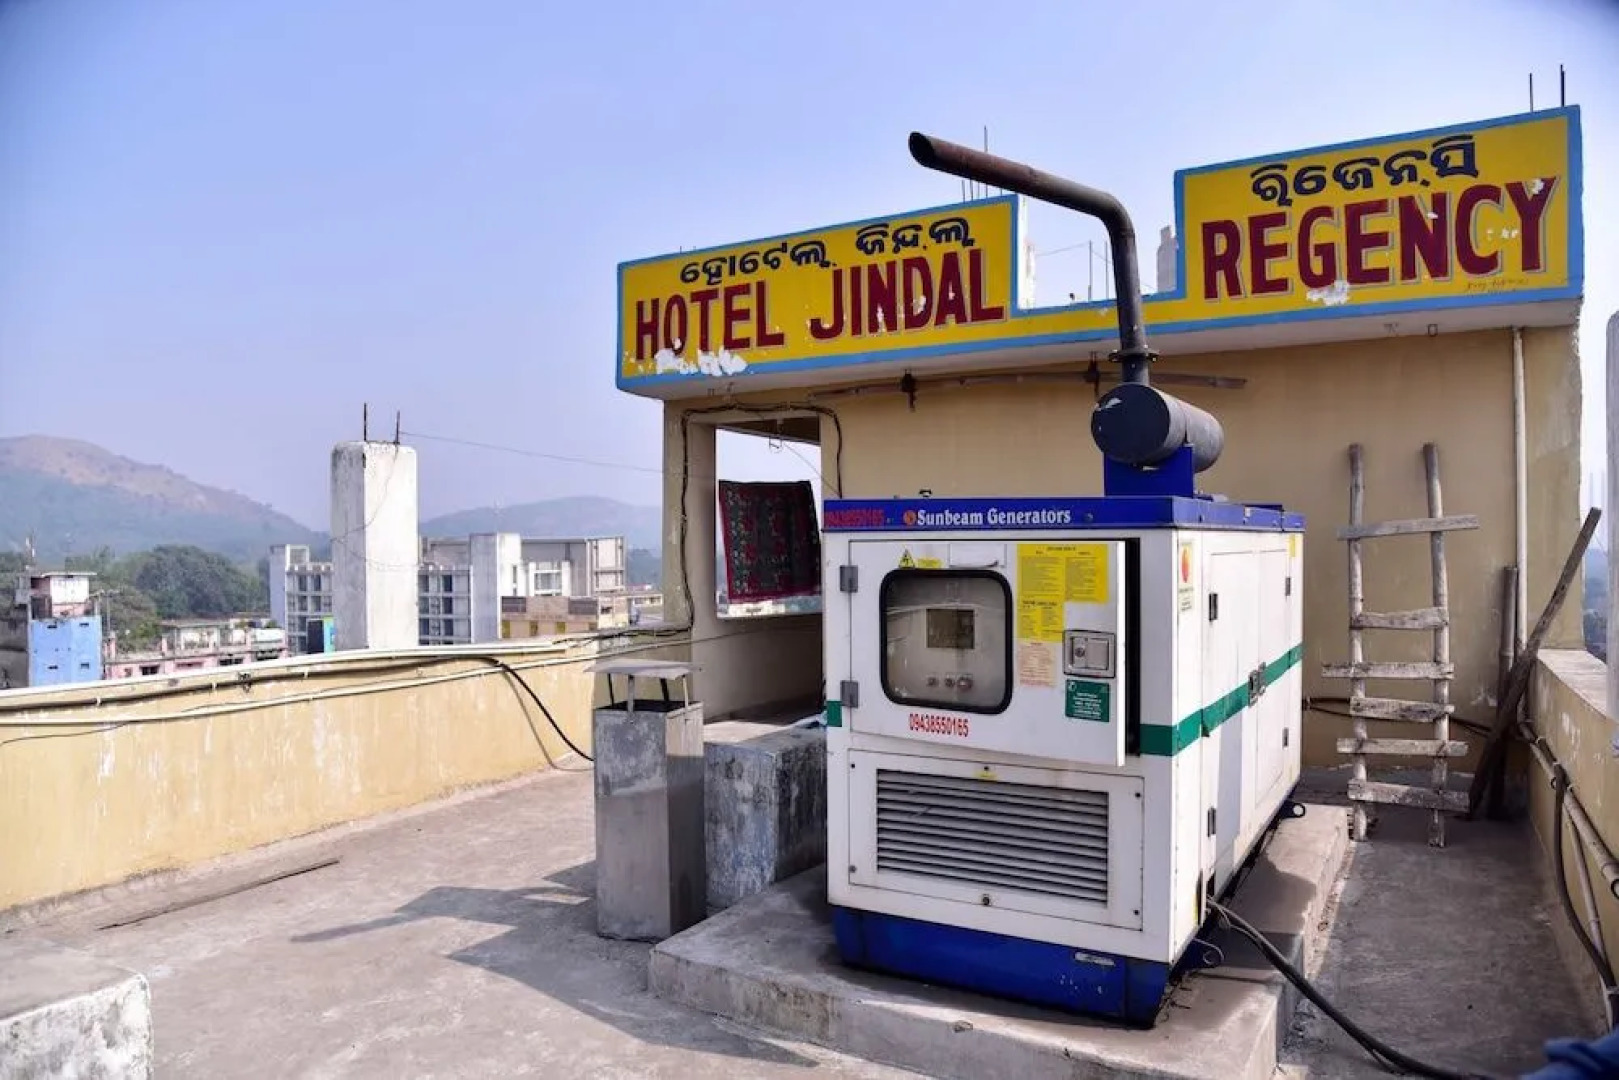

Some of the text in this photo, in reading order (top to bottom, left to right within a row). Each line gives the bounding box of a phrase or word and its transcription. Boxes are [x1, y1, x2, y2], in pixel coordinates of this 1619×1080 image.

[1202, 176, 1556, 299] REGENCY
[635, 248, 1005, 361] HOTEL JINDAL
[917, 508, 1071, 526] Sunbeam Generators
